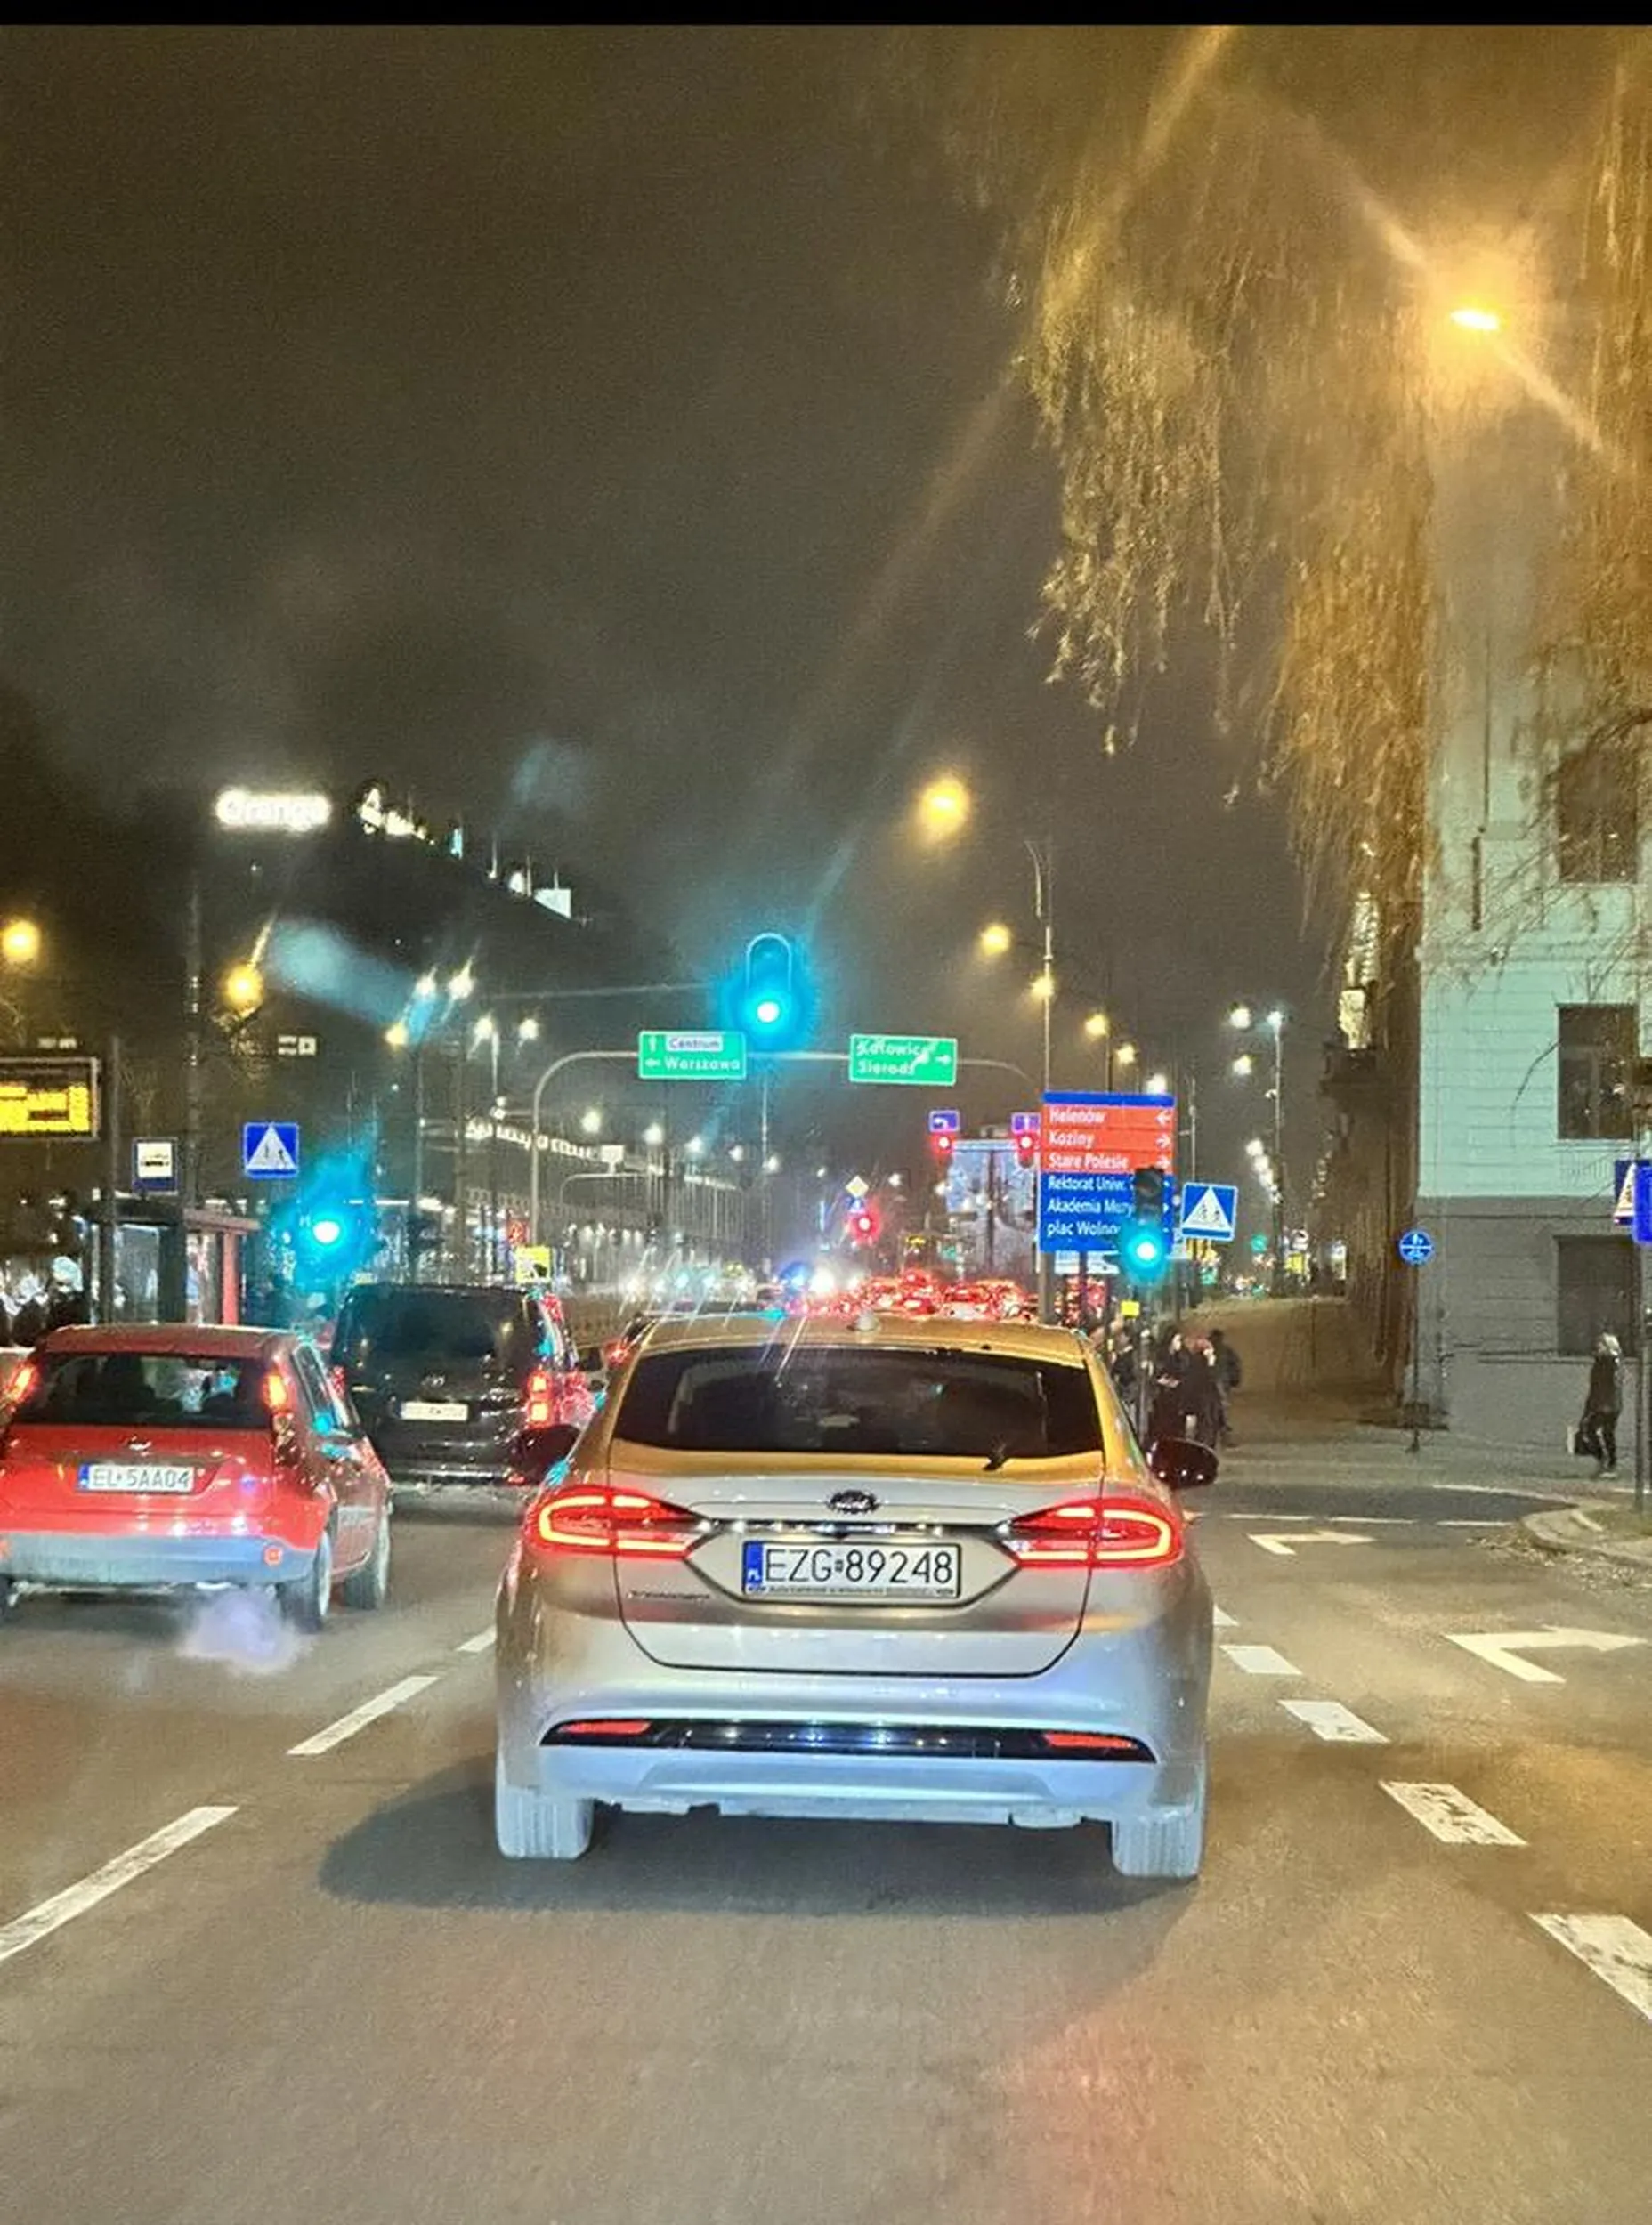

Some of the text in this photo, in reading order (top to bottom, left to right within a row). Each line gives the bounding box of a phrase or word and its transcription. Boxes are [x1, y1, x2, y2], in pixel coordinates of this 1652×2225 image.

[668, 1038, 720, 1049] Centrum
[665, 1056, 741, 1071] Warszawa
[1049, 1130, 1095, 1150] Koziny
[1049, 1153, 1130, 1170] Stare Polesie
[1048, 1175, 1095, 1191] Rektorat
[1047, 1198, 1134, 1218] Akademia Muzy
[1047, 1220, 1122, 1238] plac Wolno
[765, 1549, 952, 1584] EZG 89248
